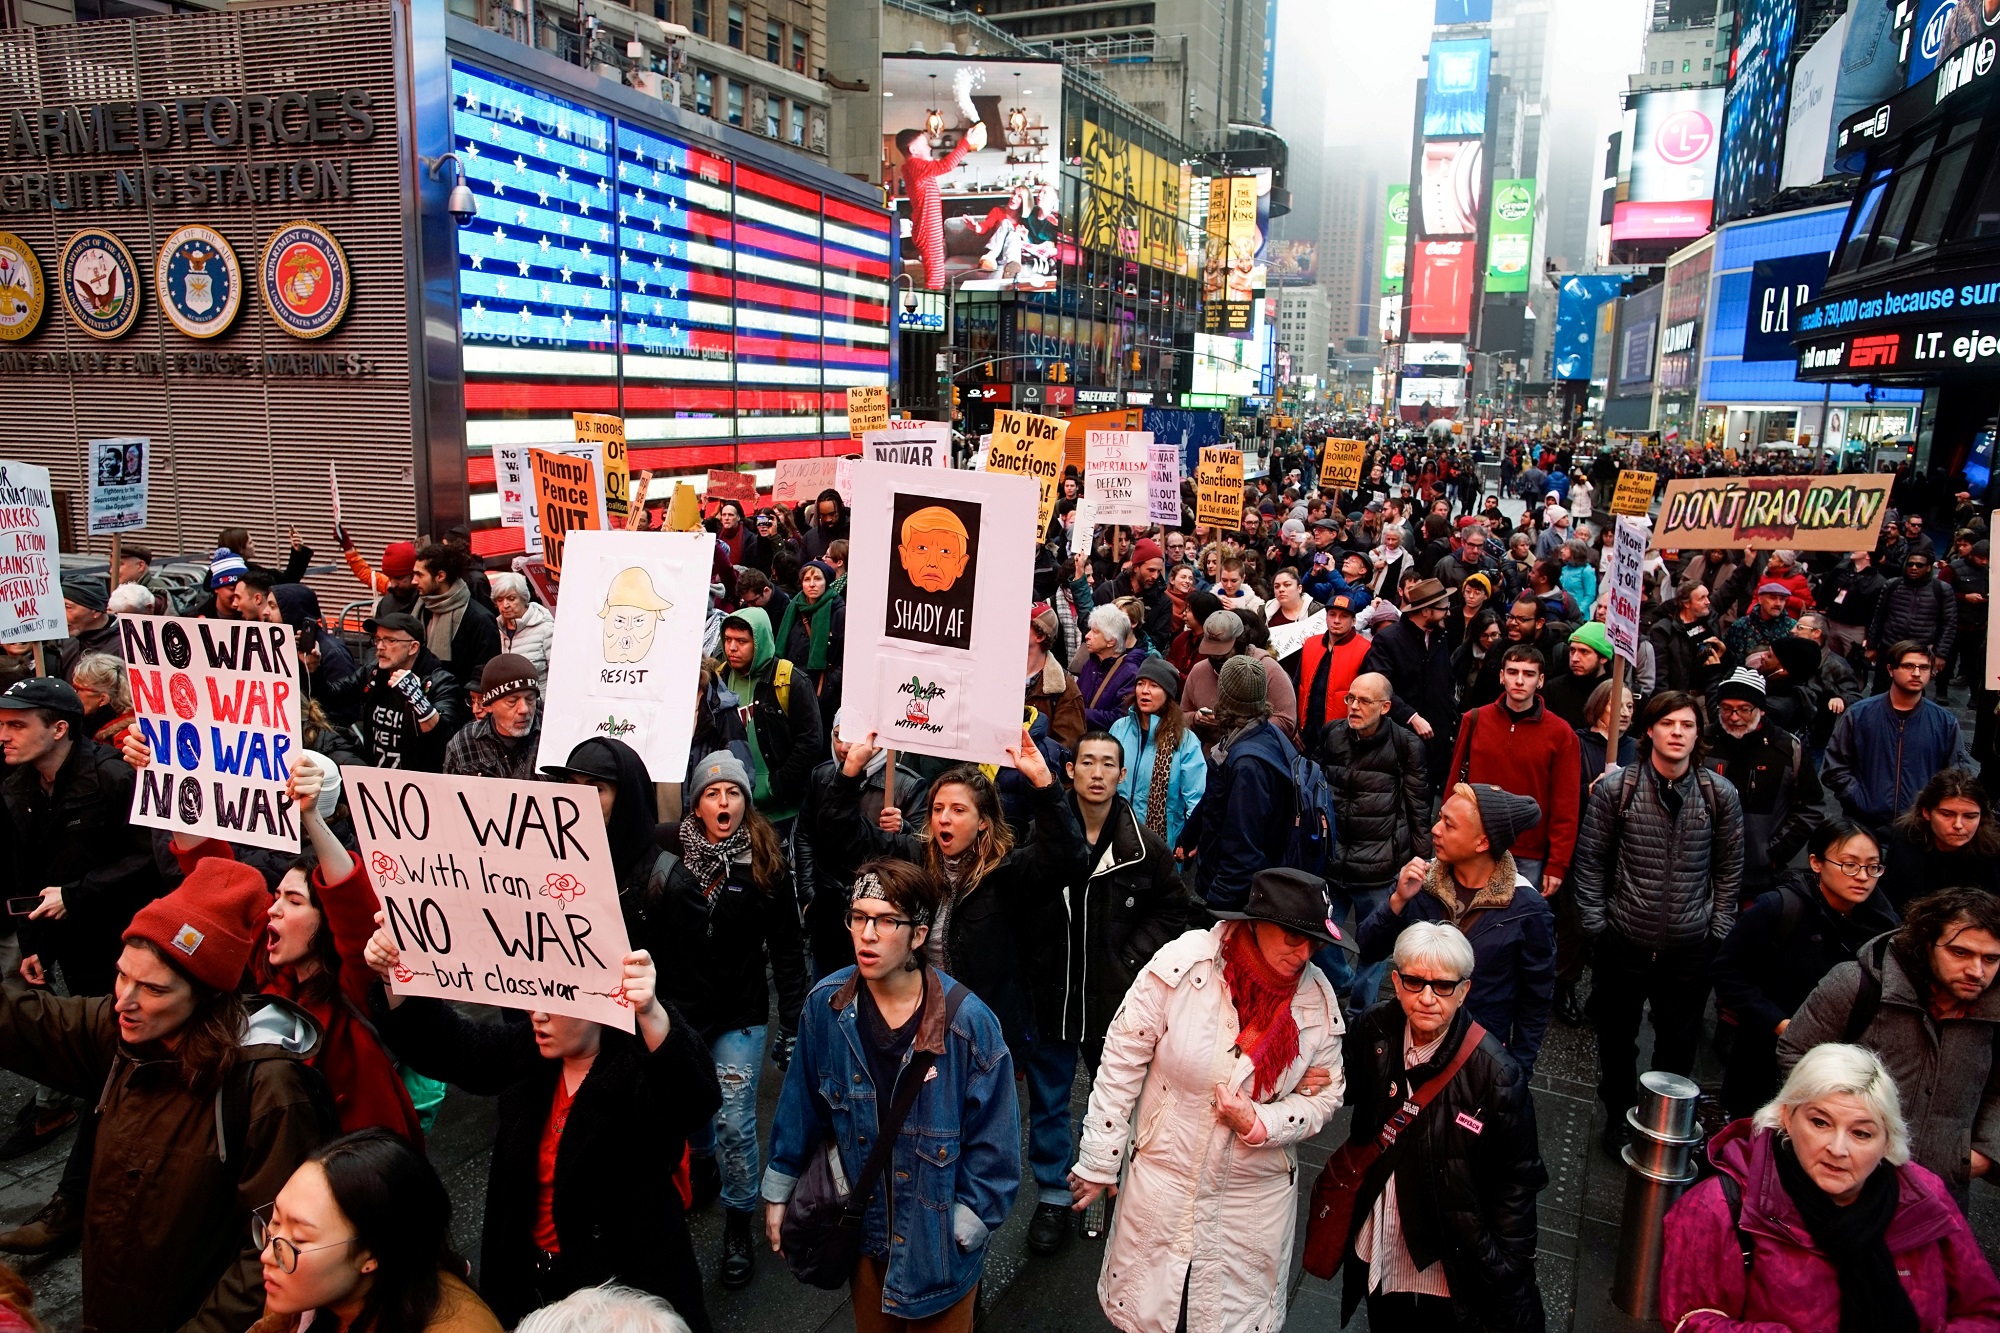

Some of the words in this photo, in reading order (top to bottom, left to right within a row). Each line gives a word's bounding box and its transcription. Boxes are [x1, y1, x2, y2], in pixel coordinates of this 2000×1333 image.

[6, 101, 171, 157] ARMED
[175, 88, 374, 147] FORCES
[183, 158, 349, 203] STATION
[1236, 189, 1250, 198] THE
[1233, 197, 1252, 209] LION
[1232, 209, 1254, 223] KING
[1824, 299, 1858, 329] 750,000
[1858, 299, 1882, 321] cars
[1884, 286, 1955, 317] because
[1029, 332, 1072, 359] SIESTA
[1077, 340, 1100, 361] KEY
[264, 353, 362, 376] MARINES
[851, 389, 863, 398] No
[865, 387, 883, 397] War
[1077, 390, 1119, 403] SKECHER
[849, 403, 886, 413] Sanctions
[864, 414, 885, 423] Iran!
[576, 420, 592, 432] U.S.
[593, 422, 623, 436] TROOPS
[1000, 413, 1021, 435] No
[1026, 416, 1058, 441] War
[1016, 439, 1034, 452] or
[1092, 432, 1131, 445] DEFEAT
[1106, 447, 1122, 458] US
[1333, 442, 1358, 453] STOP
[989, 447, 1057, 477] Sanctions
[1158, 453, 1175, 463] WAR
[1204, 452, 1217, 463] No
[1219, 451, 1240, 465] War
[1326, 453, 1362, 463] BOMBING
[536, 452, 589, 486] Trump/
[1087, 461, 1148, 472] IMPERIALISM
[1215, 465, 1225, 474] or
[1324, 465, 1358, 481] IRAQ!
[1096, 477, 1132, 489] DEFEND
[1200, 472, 1242, 489] Sanctions
[1624, 472, 1636, 480] No
[1637, 473, 1653, 482] War
[542, 476, 589, 507] Pence
[1105, 489, 1133, 499] IRAN
[1159, 489, 1176, 500] OUT
[1201, 493, 1212, 502] on
[1213, 490, 1240, 505] Iran!
[1617, 484, 1652, 495] Sanctions
[1628, 495, 1648, 504] Iran!
[1742, 488, 1801, 529] IRAQ
[1801, 486, 1885, 530] IRAN
[546, 502, 589, 535] OUT
[15, 534, 46, 553] ACTION
[14, 598, 39, 619] WAR
[893, 598, 943, 636] SHADY
[944, 608, 965, 638] AF
[121, 618, 193, 669] NO
[198, 624, 293, 678] WAR
[398, 677, 410, 690] NO
[600, 669, 649, 685] RESIST
[897, 682, 917, 695] NO
[919, 685, 946, 700] WAR
[128, 668, 198, 720] NO
[205, 675, 292, 733] WAR
[595, 722, 612, 734] NO
[613, 723, 637, 735] WAR
[895, 718, 920, 730] WITH
[920, 722, 944, 734] IRAN
[139, 717, 202, 772] NO
[210, 726, 291, 782] WAR
[139, 770, 204, 825] NO
[213, 782, 298, 842] WAR
[357, 781, 430, 841] NO
[457, 792, 590, 862] WAR
[479, 856, 531, 901] Iran
[385, 895, 452, 955] NO
[482, 907, 608, 970] WAR
[431, 960, 474, 992] but
[1458, 1115, 1481, 1131] IMPEACH
